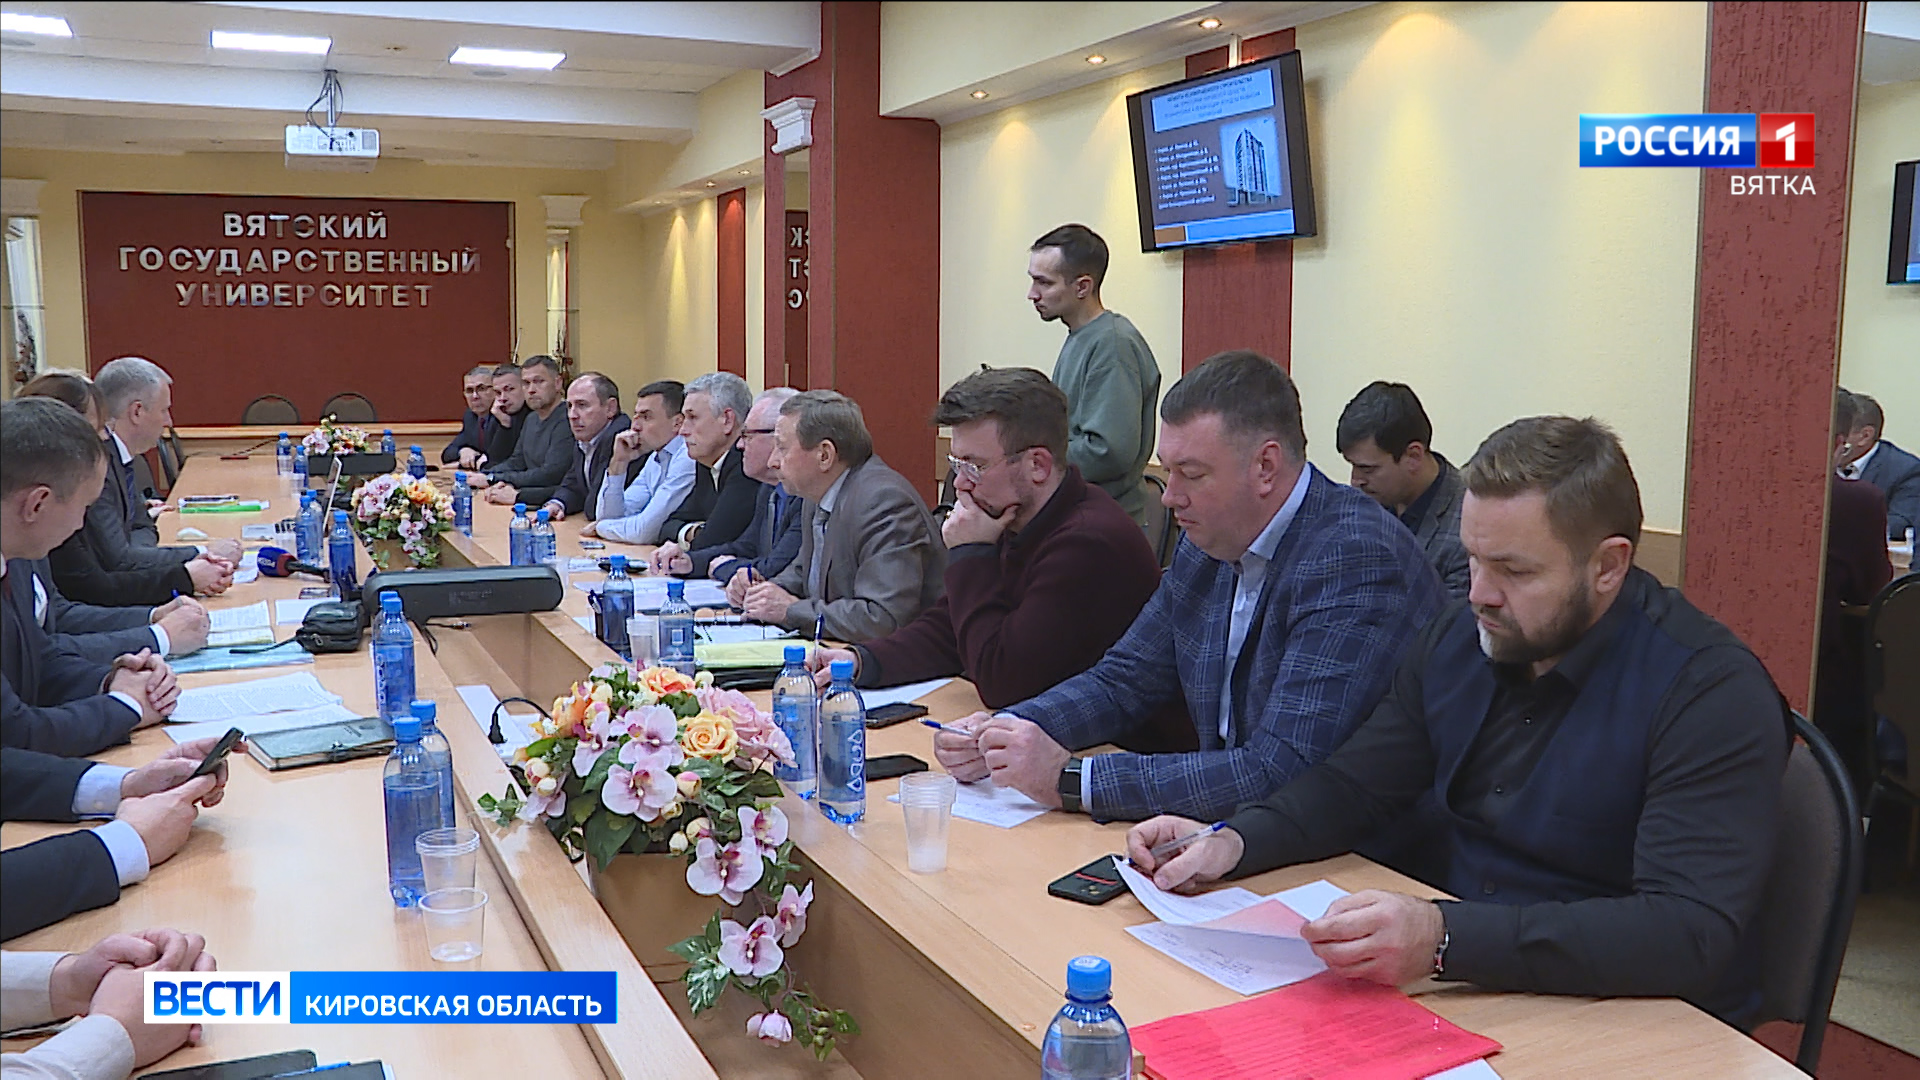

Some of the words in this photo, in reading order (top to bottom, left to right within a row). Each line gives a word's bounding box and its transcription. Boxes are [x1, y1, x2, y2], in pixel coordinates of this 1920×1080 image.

[223, 210, 388, 239] ВЯТСКИЙ
[119, 246, 481, 276] ГОСУДАРСТВЕННЫЙ
[176, 283, 433, 307] УНИВЕРСИТЕТ
